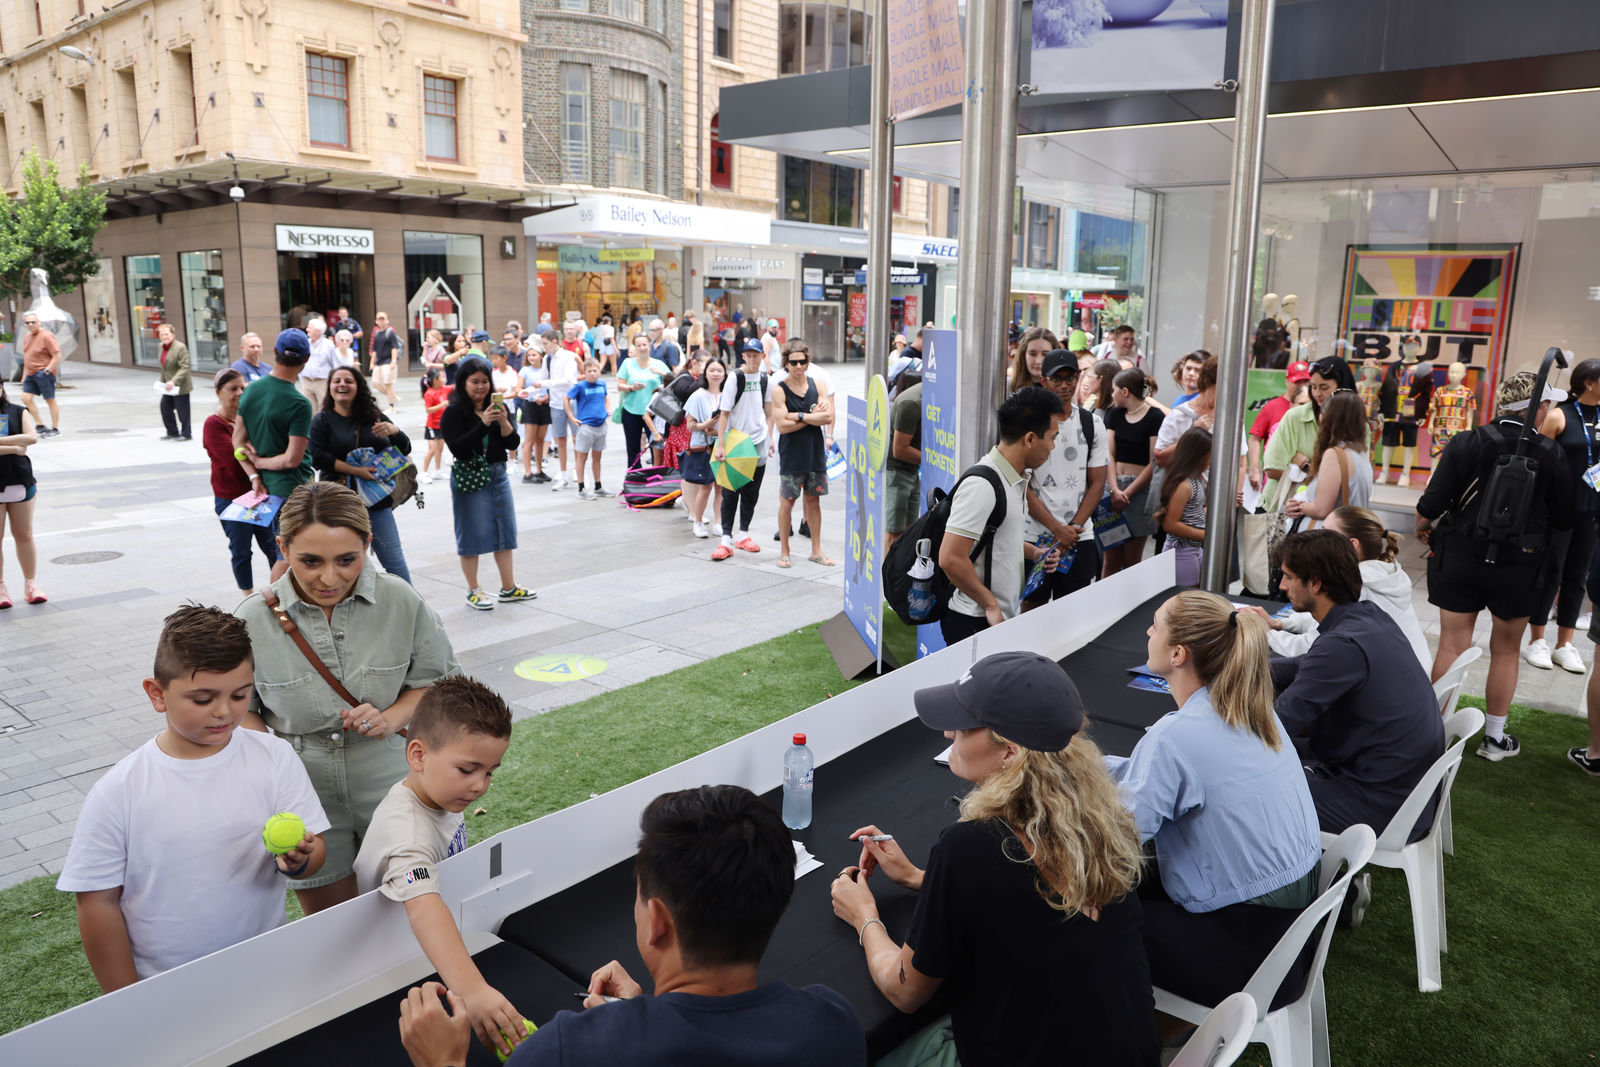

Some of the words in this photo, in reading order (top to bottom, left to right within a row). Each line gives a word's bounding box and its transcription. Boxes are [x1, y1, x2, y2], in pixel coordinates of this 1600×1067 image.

[890, 17, 926, 46] RUNDLE
[927, 3, 955, 31] MALL
[891, 40, 928, 69] RUNDLE
[929, 29, 958, 55] MALL
[892, 64, 930, 92] RUNDLE
[931, 54, 961, 78] MALL
[895, 87, 932, 114] RUNDLE
[934, 78, 963, 102] MALL
[611, 204, 647, 226] Bailey
[652, 209, 692, 227] Nelson
[286, 229, 370, 248] NESPRESSO
[561, 252, 587, 267] Bailey
[1374, 301, 1468, 331] SMALL
[1353, 333, 1488, 364] BUT
[926, 403, 942, 423] GET
[934, 427, 956, 450] YOUR
[925, 447, 956, 476] TICKETS
[412, 867, 430, 881] NBA
